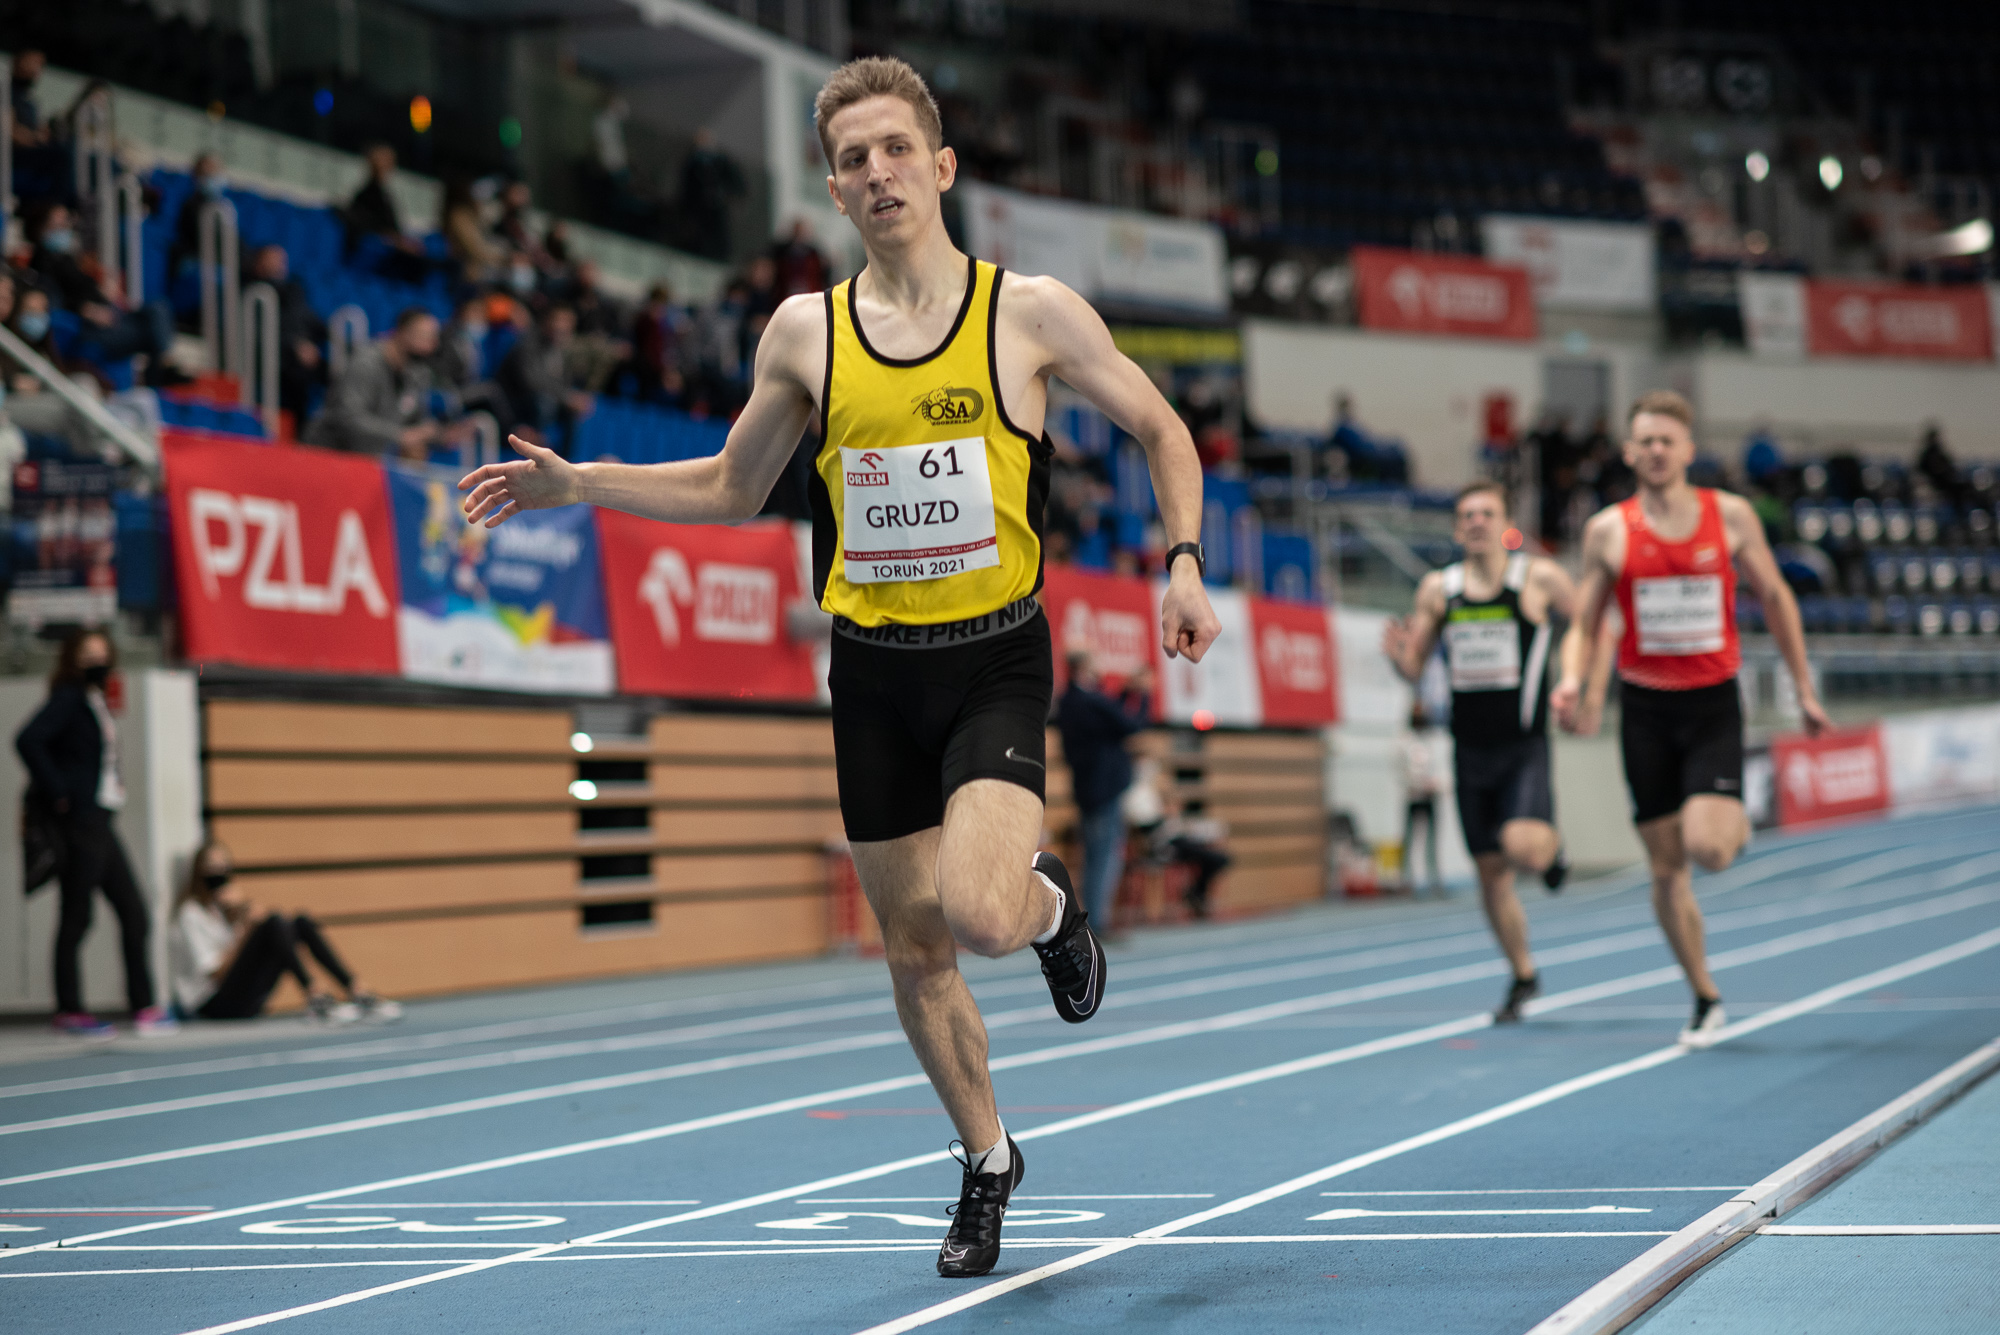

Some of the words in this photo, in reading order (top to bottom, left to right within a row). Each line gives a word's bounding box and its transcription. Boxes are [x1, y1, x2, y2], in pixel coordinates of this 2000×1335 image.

[929, 401, 969, 420] OSA
[919, 446, 963, 479] 61
[848, 473, 886, 485] ORLEN
[866, 500, 959, 528] GRUZD
[188, 487, 389, 619] PZLA
[891, 549, 938, 558] MISTRZOSTWA
[872, 560, 924, 578] TORUŃ
[930, 558, 964, 575] 2021
[854, 623, 920, 645] NIKE
[927, 614, 990, 644] PRO
